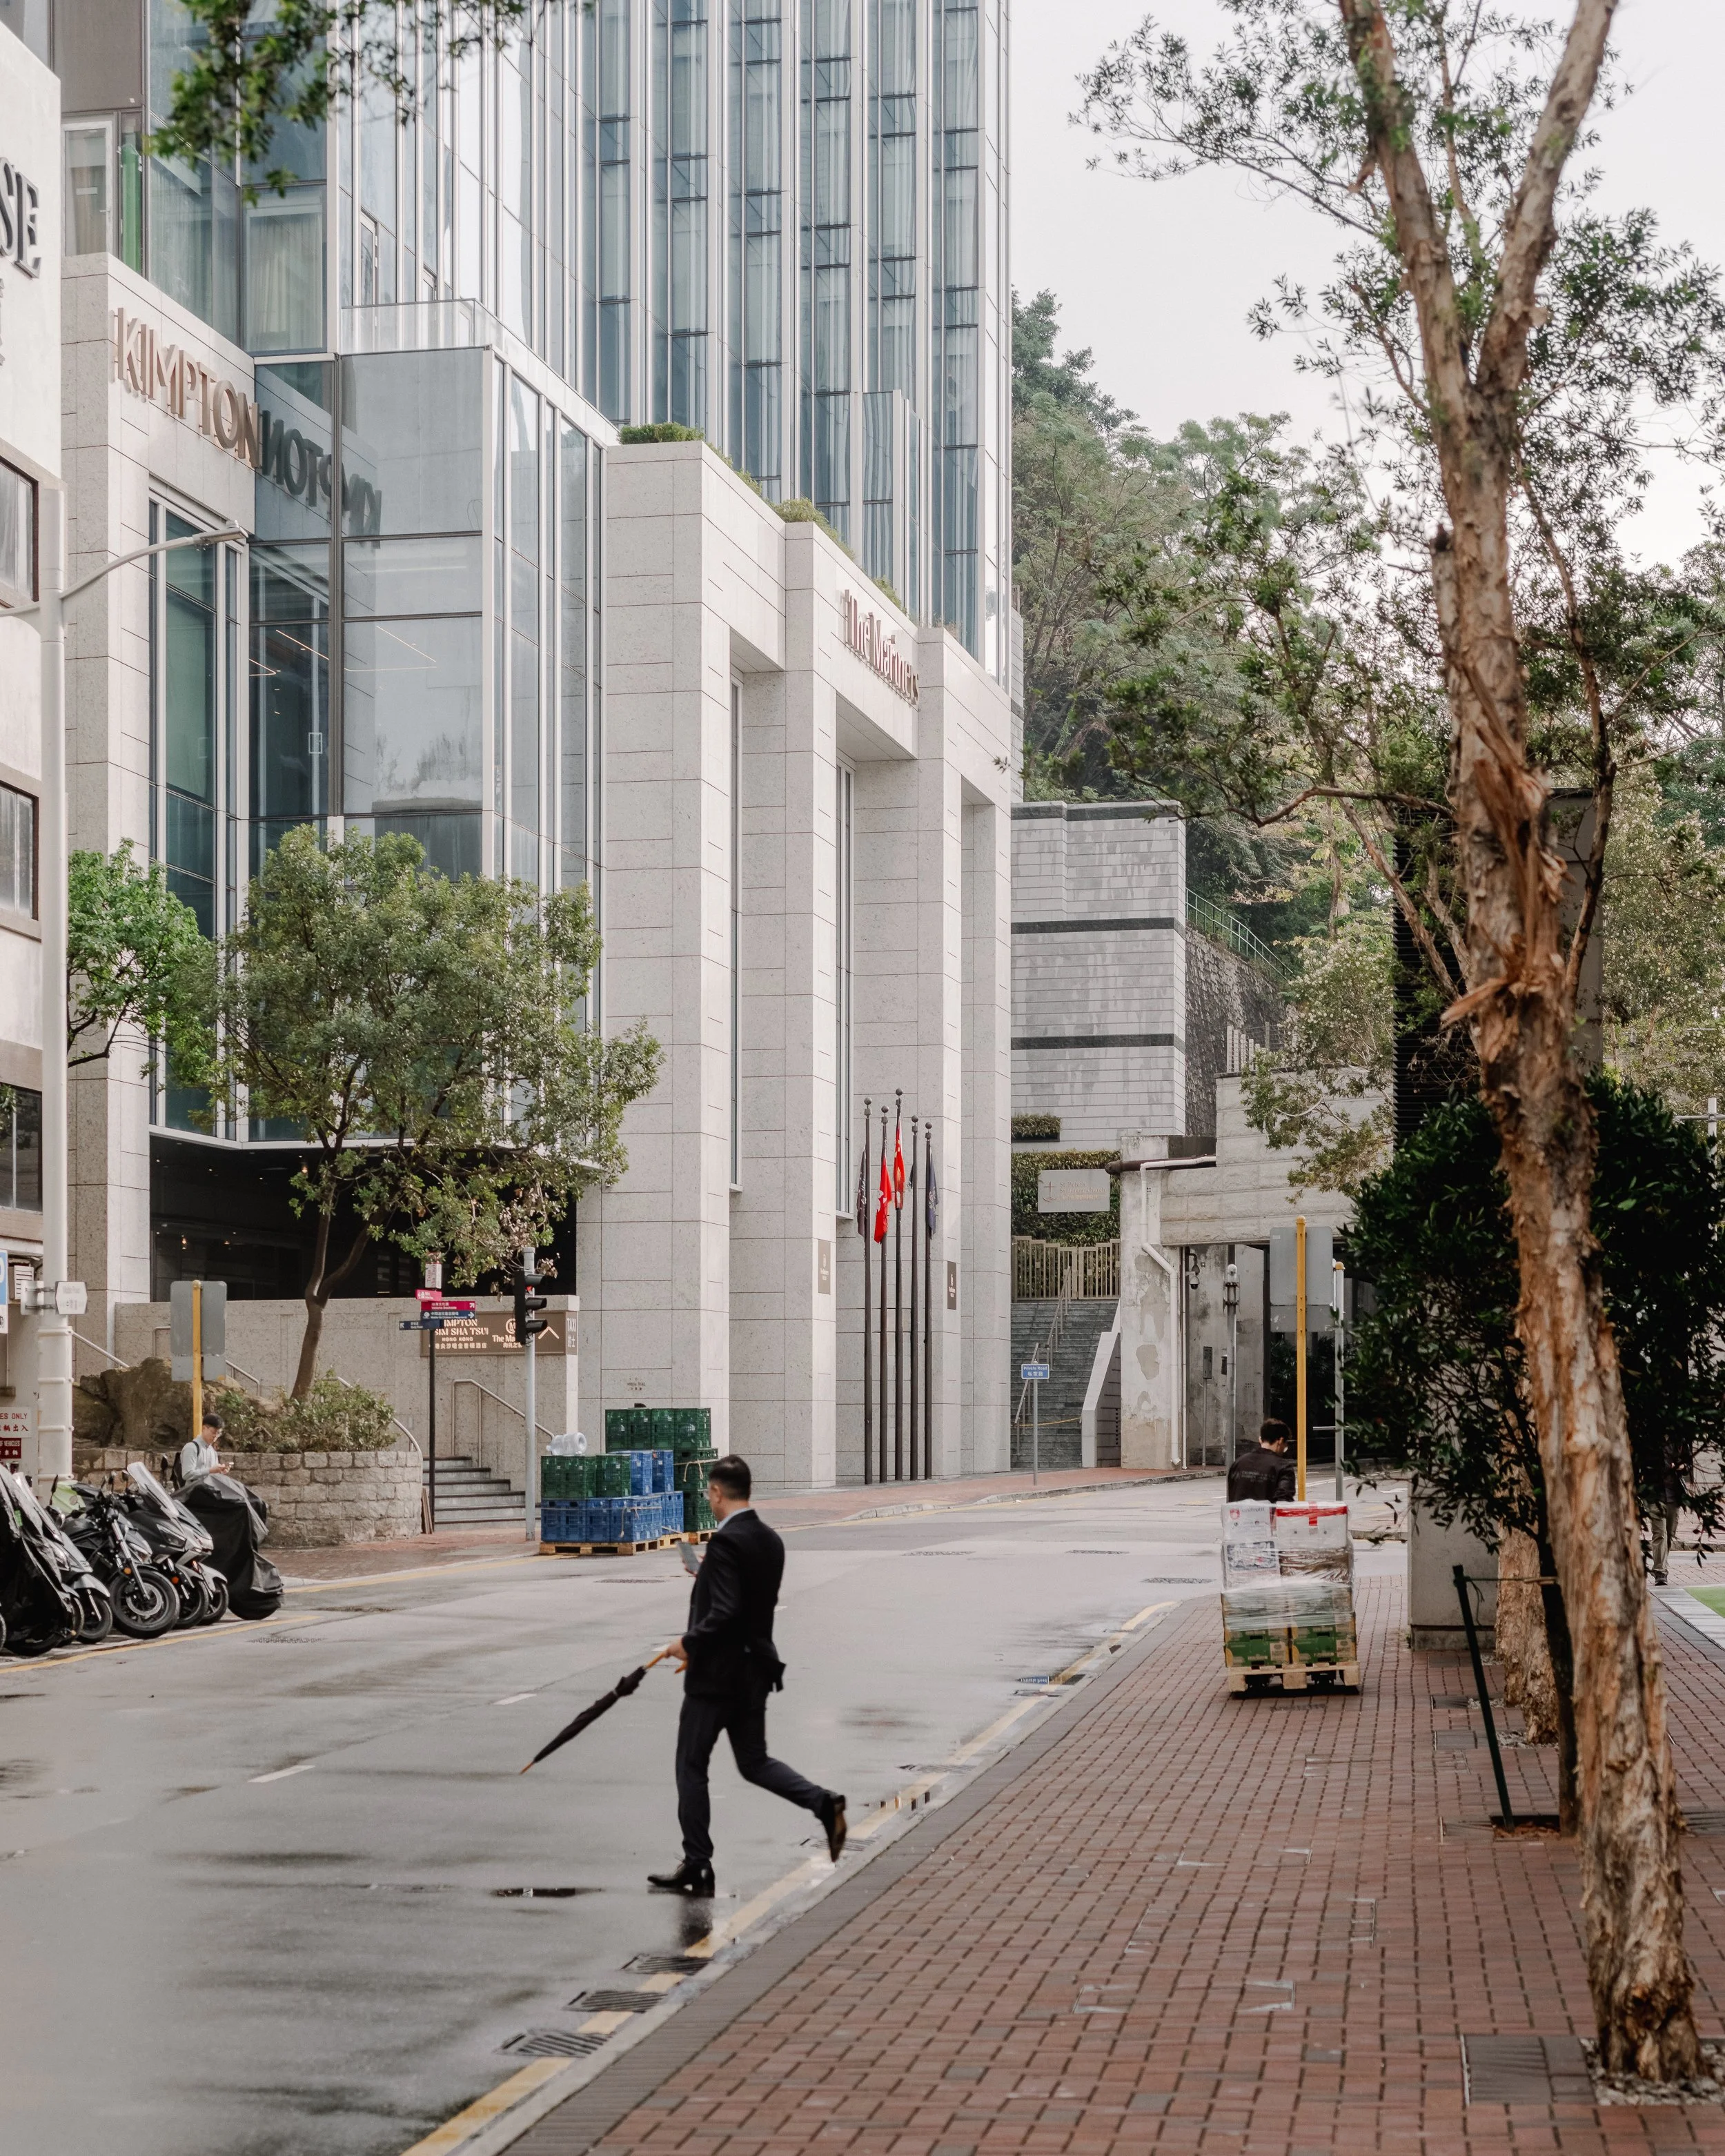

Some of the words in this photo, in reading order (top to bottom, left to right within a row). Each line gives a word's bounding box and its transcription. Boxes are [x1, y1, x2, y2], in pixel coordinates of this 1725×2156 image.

[117, 308, 260, 469] KIMPTON
[868, 611, 919, 706] Mariners
[444, 1318, 478, 1327] IMPTON
[566, 1318, 576, 1332] TAXI
[469, 1327, 489, 1336] TSUI
